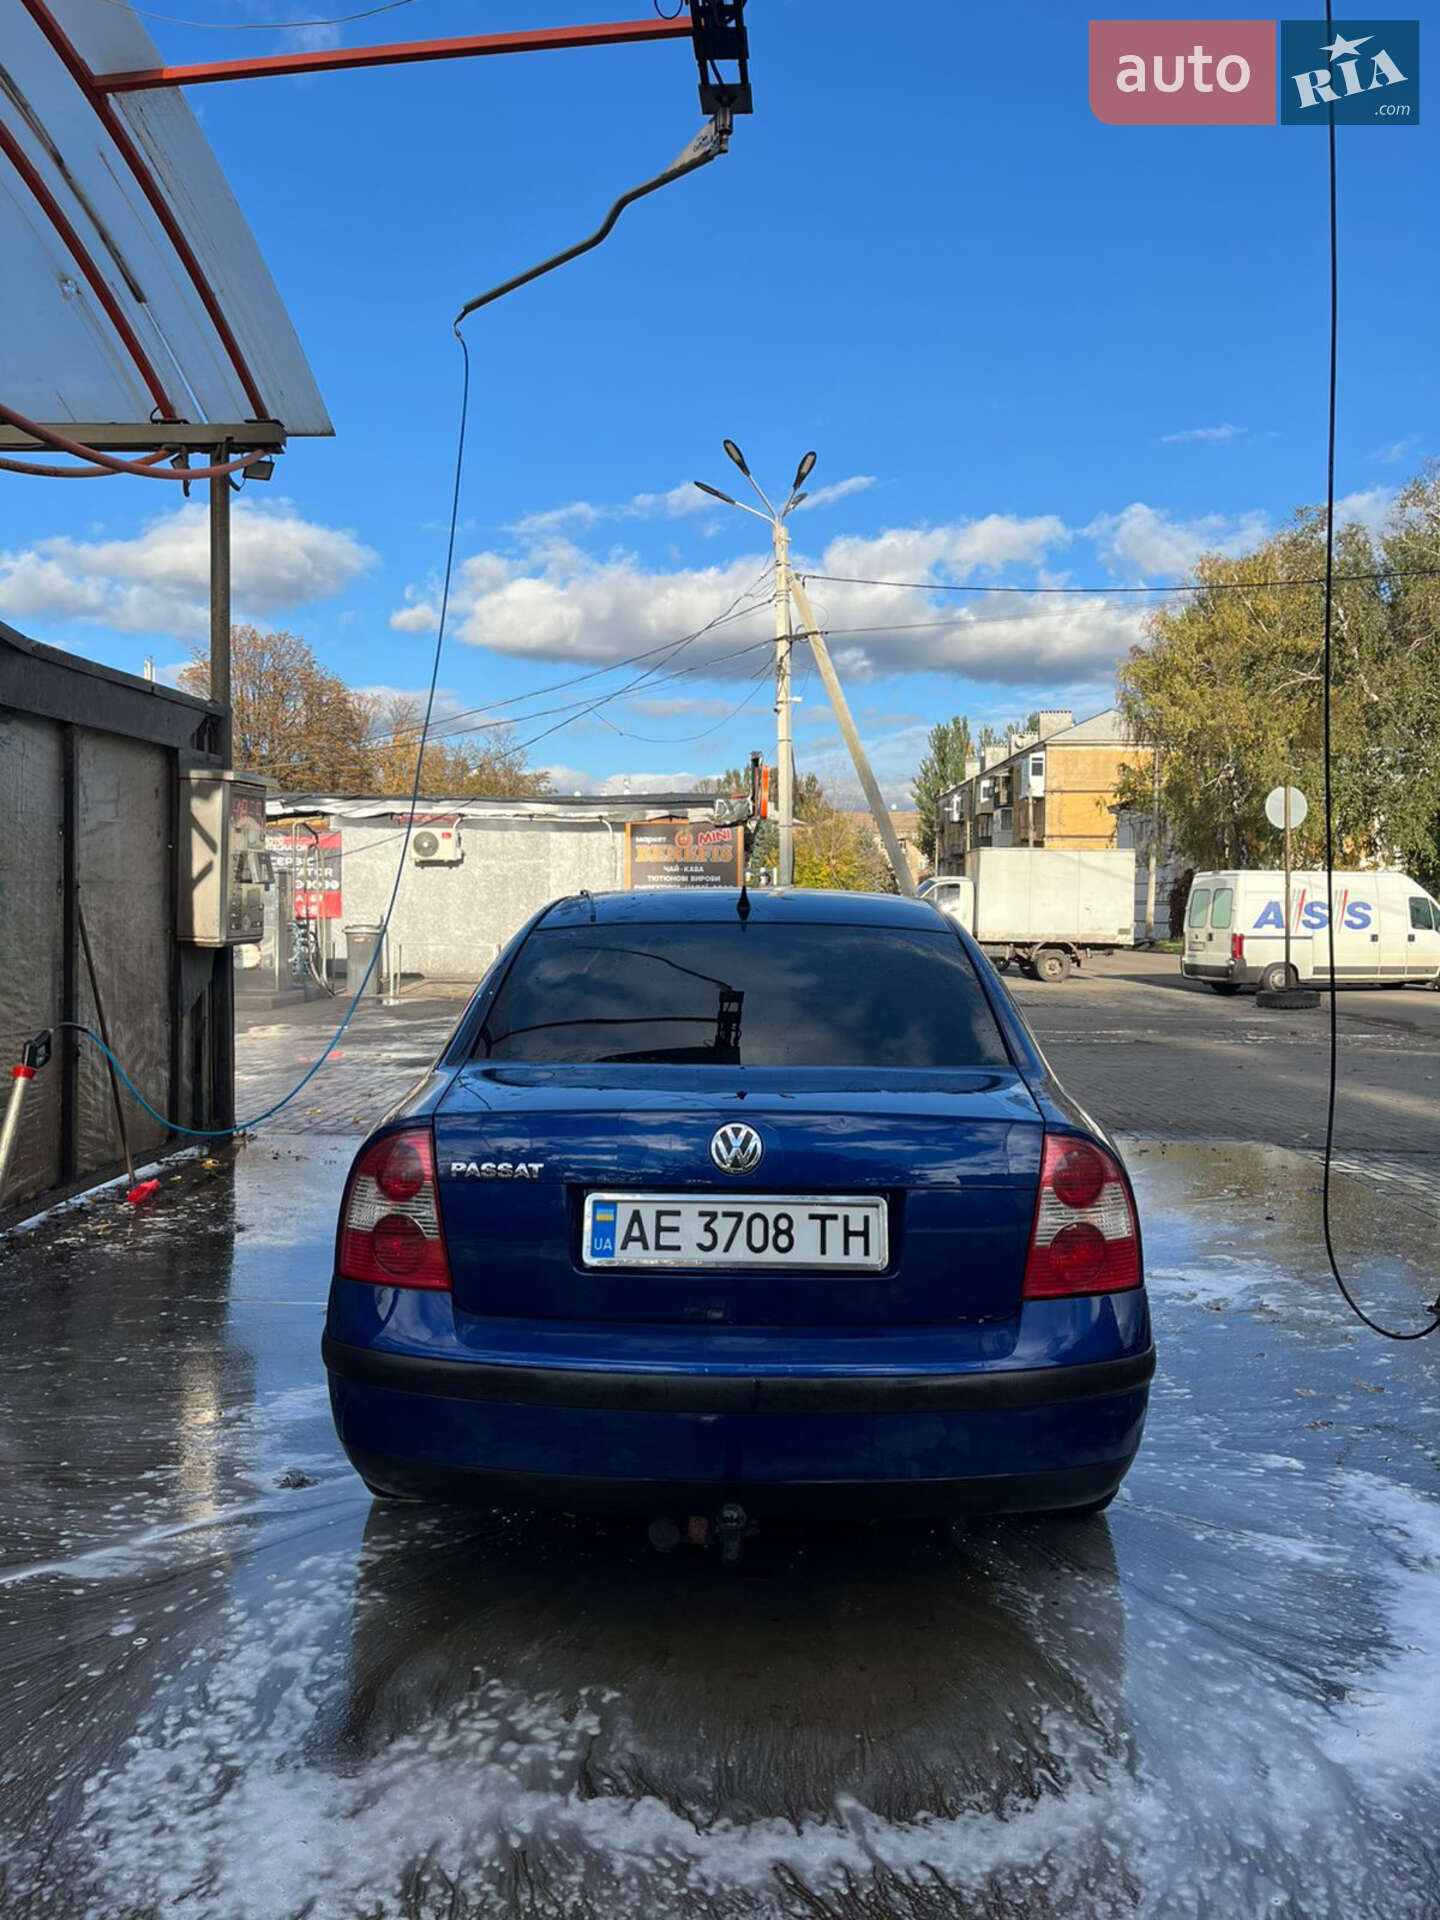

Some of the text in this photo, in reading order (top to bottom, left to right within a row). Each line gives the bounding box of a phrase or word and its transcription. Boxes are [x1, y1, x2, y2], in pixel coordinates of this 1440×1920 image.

[698, 828, 731, 846] MINI
[451, 1162, 545, 1178] PASSAT
[619, 1209, 871, 1257] AE 3708 TH
[594, 1236, 613, 1252] UA
